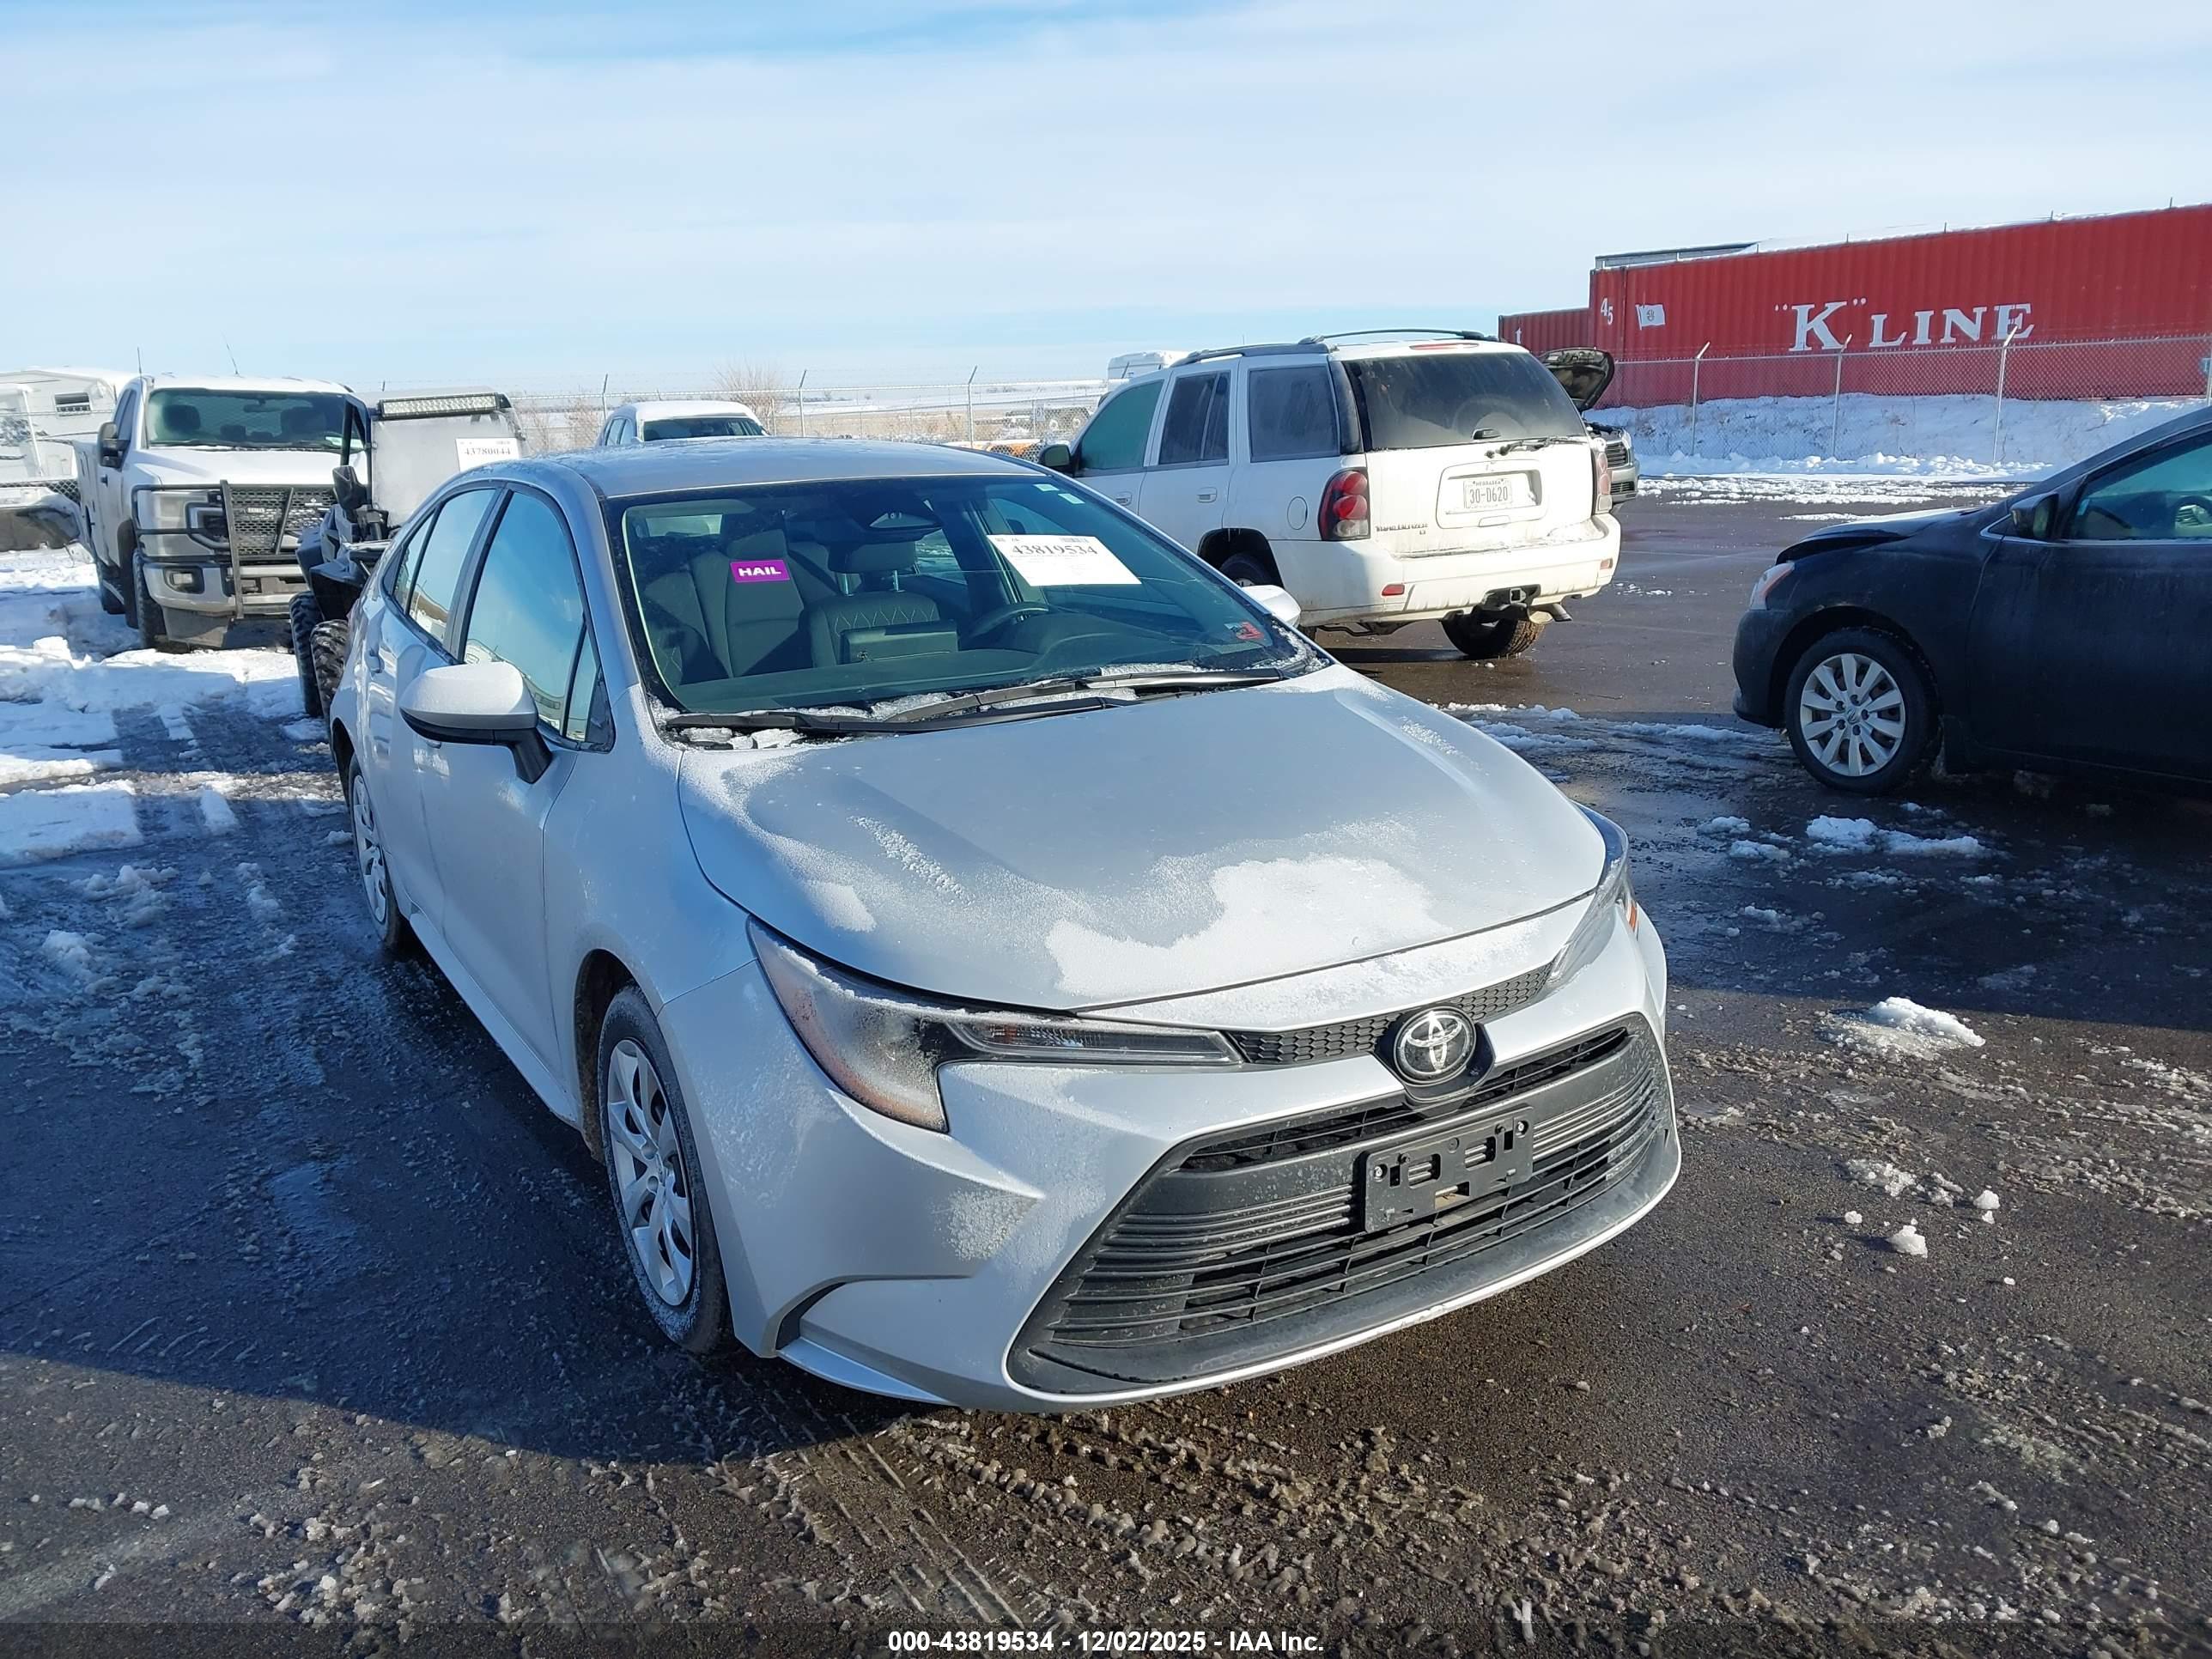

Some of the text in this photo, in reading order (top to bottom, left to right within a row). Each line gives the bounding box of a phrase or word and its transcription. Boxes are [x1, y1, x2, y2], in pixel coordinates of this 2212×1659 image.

[1600, 297, 1613, 325] 45
[1869, 302, 2035, 348] LINE
[1469, 486, 1509, 504] 30-D620
[1012, 544, 1098, 556] 43819534
[738, 566, 782, 577] HAIL
